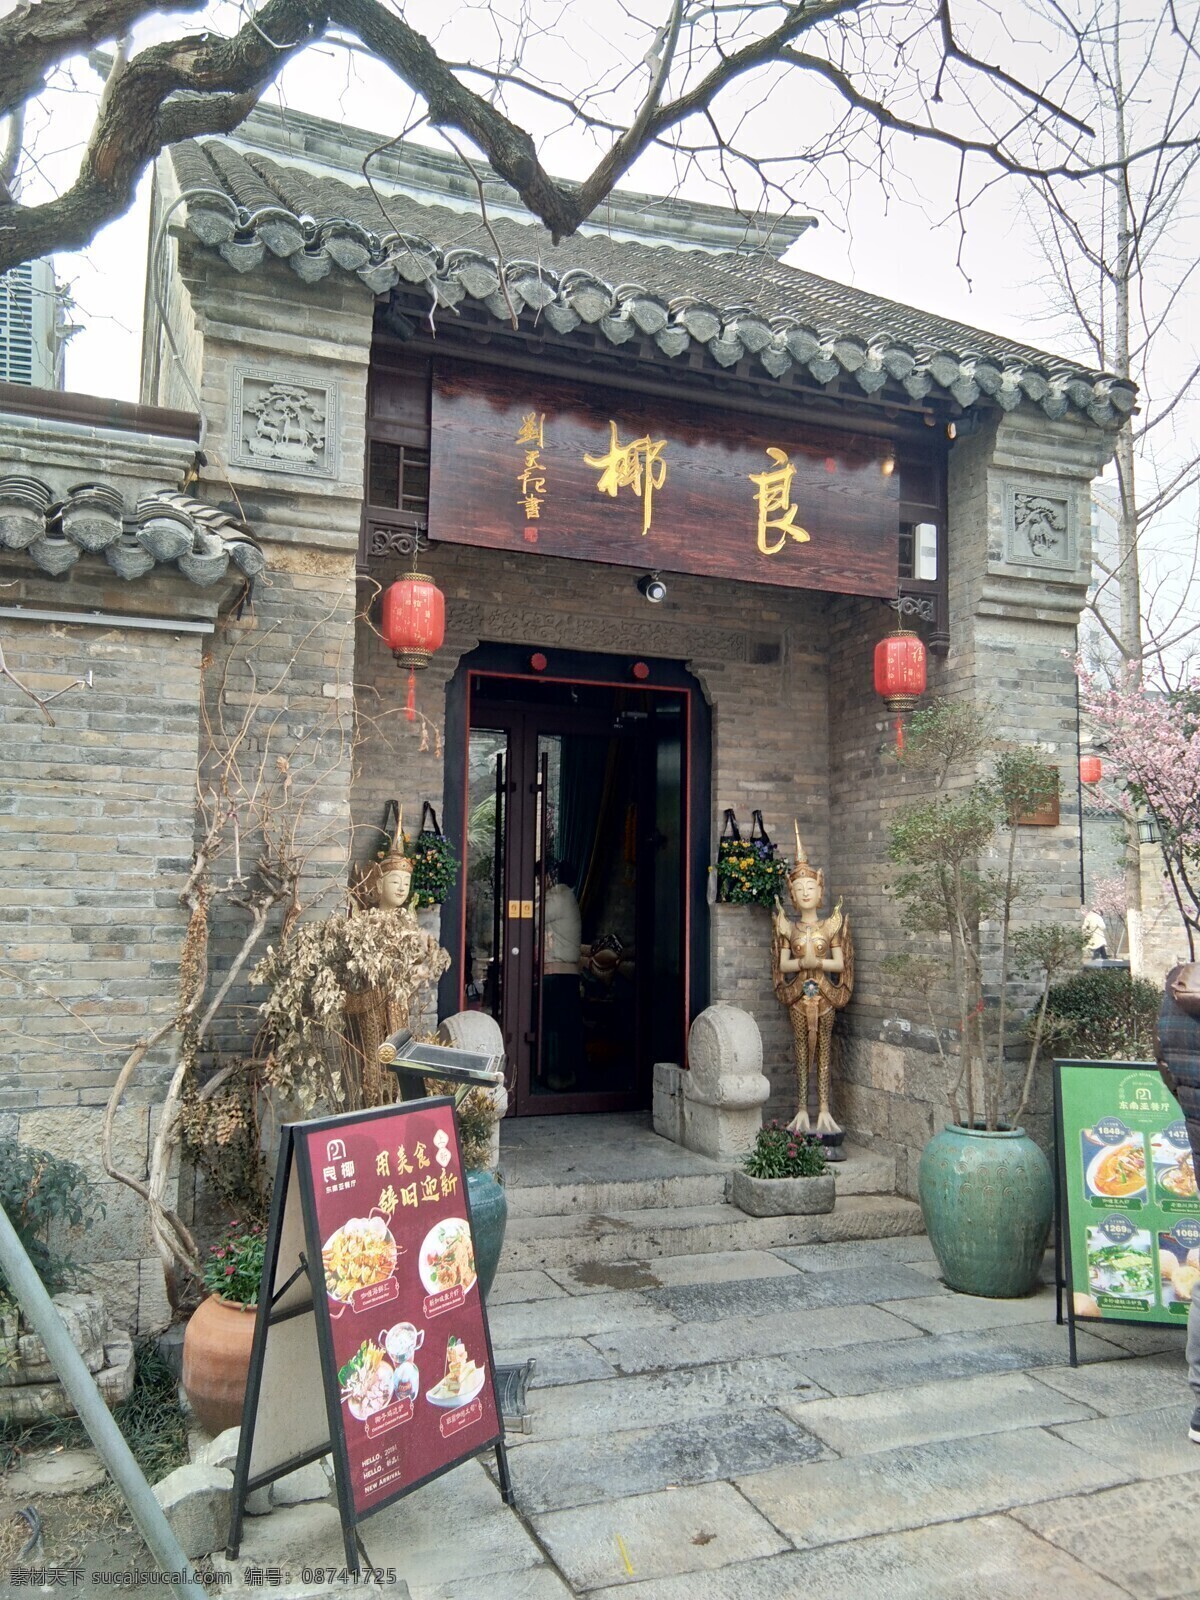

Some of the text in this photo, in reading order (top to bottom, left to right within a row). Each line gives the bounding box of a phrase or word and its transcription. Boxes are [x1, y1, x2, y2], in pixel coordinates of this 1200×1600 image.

[1119, 1101, 1169, 1112] 东南亚餐厅
[375, 1141, 431, 1177] 用美食
[323, 1160, 356, 1183] 良椰
[325, 1180, 357, 1194] 东南亚餐厅
[378, 1168, 458, 1215] 辞旧迎新
